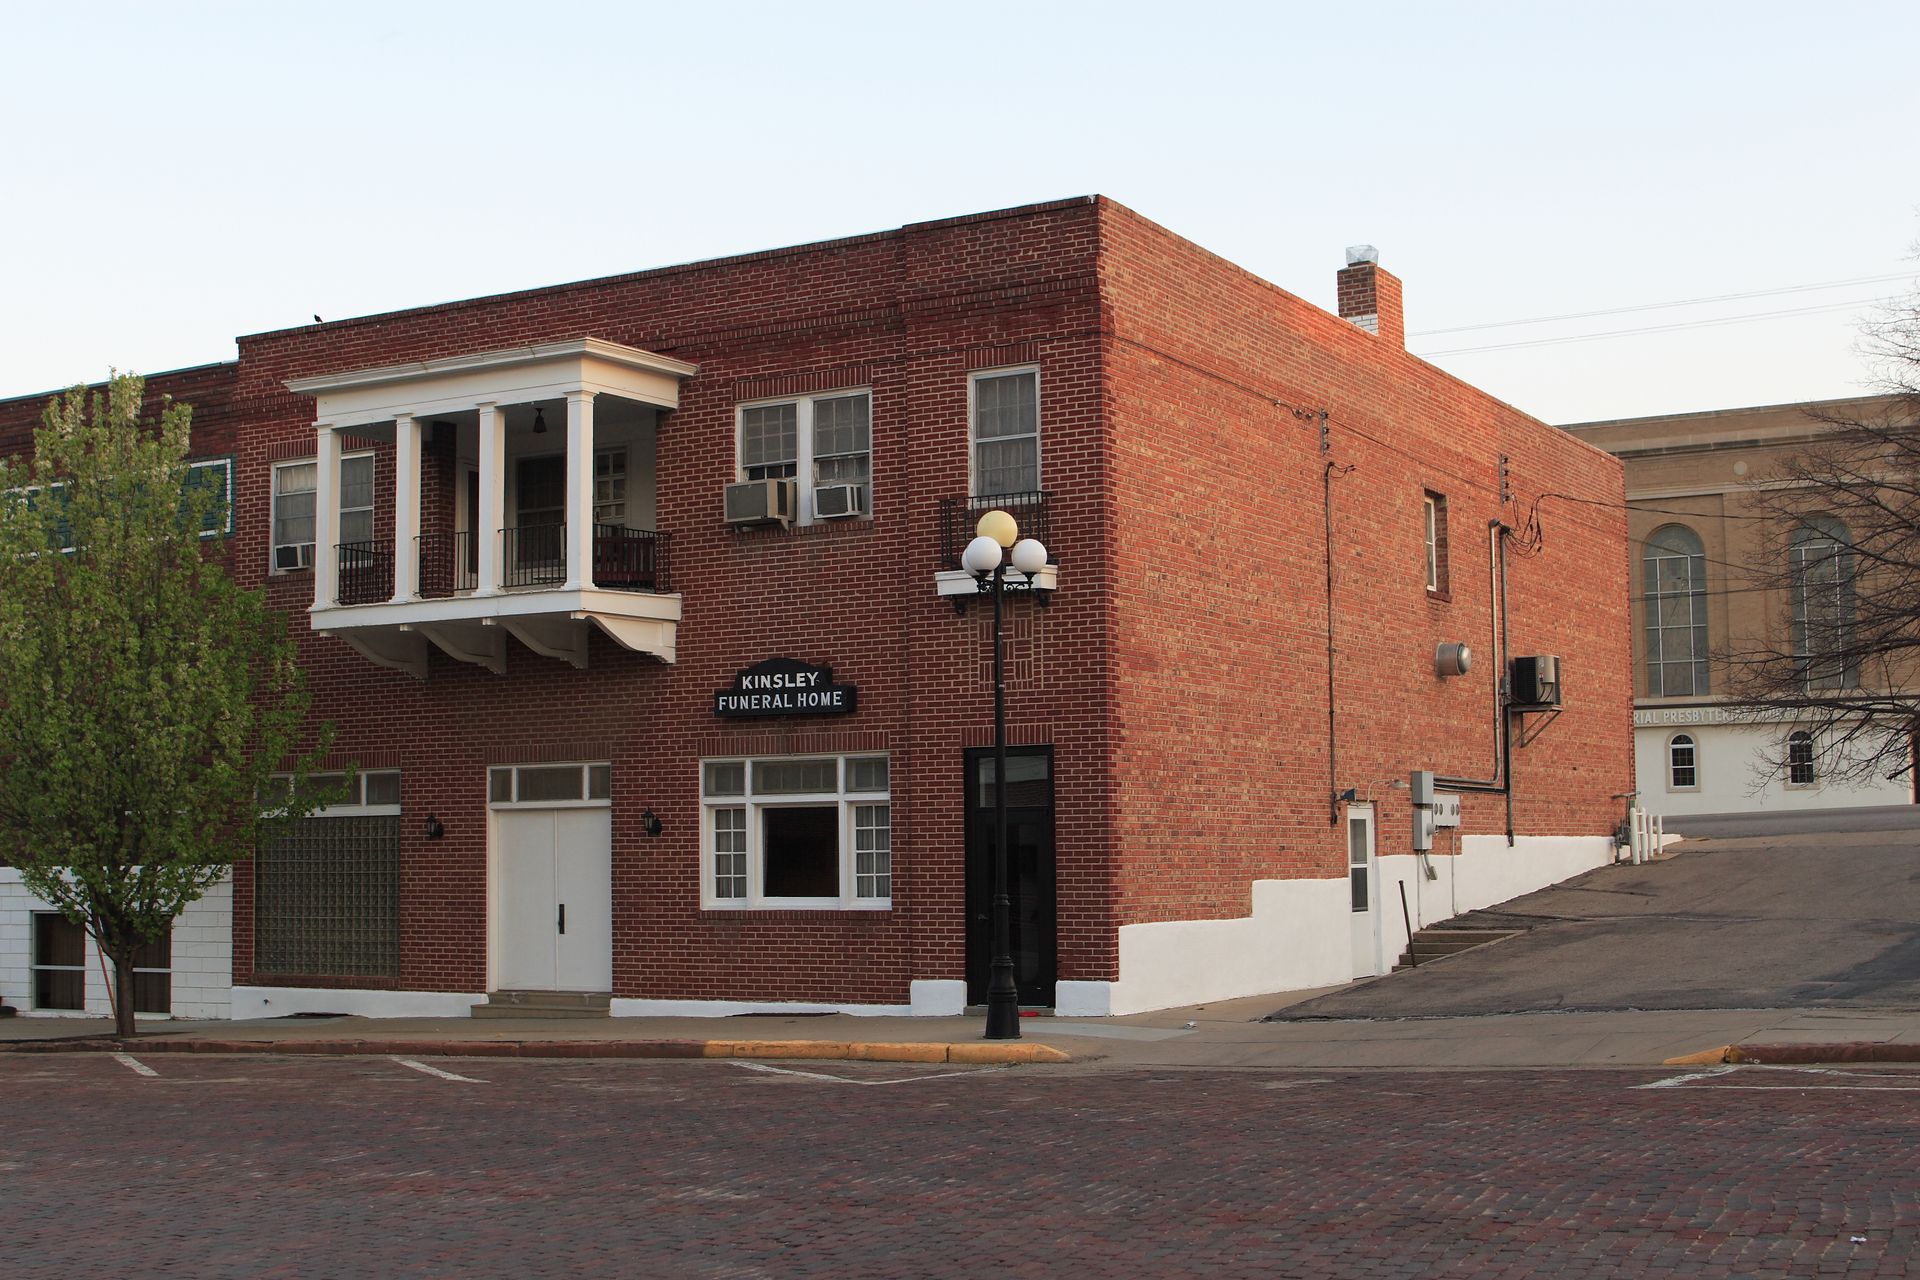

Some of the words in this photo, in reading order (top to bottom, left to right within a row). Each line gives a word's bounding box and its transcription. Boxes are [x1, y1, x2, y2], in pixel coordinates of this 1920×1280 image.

[742, 672, 819, 690] KINSLEY
[718, 693, 793, 711] FUNERAL
[797, 691, 842, 707] HOME
